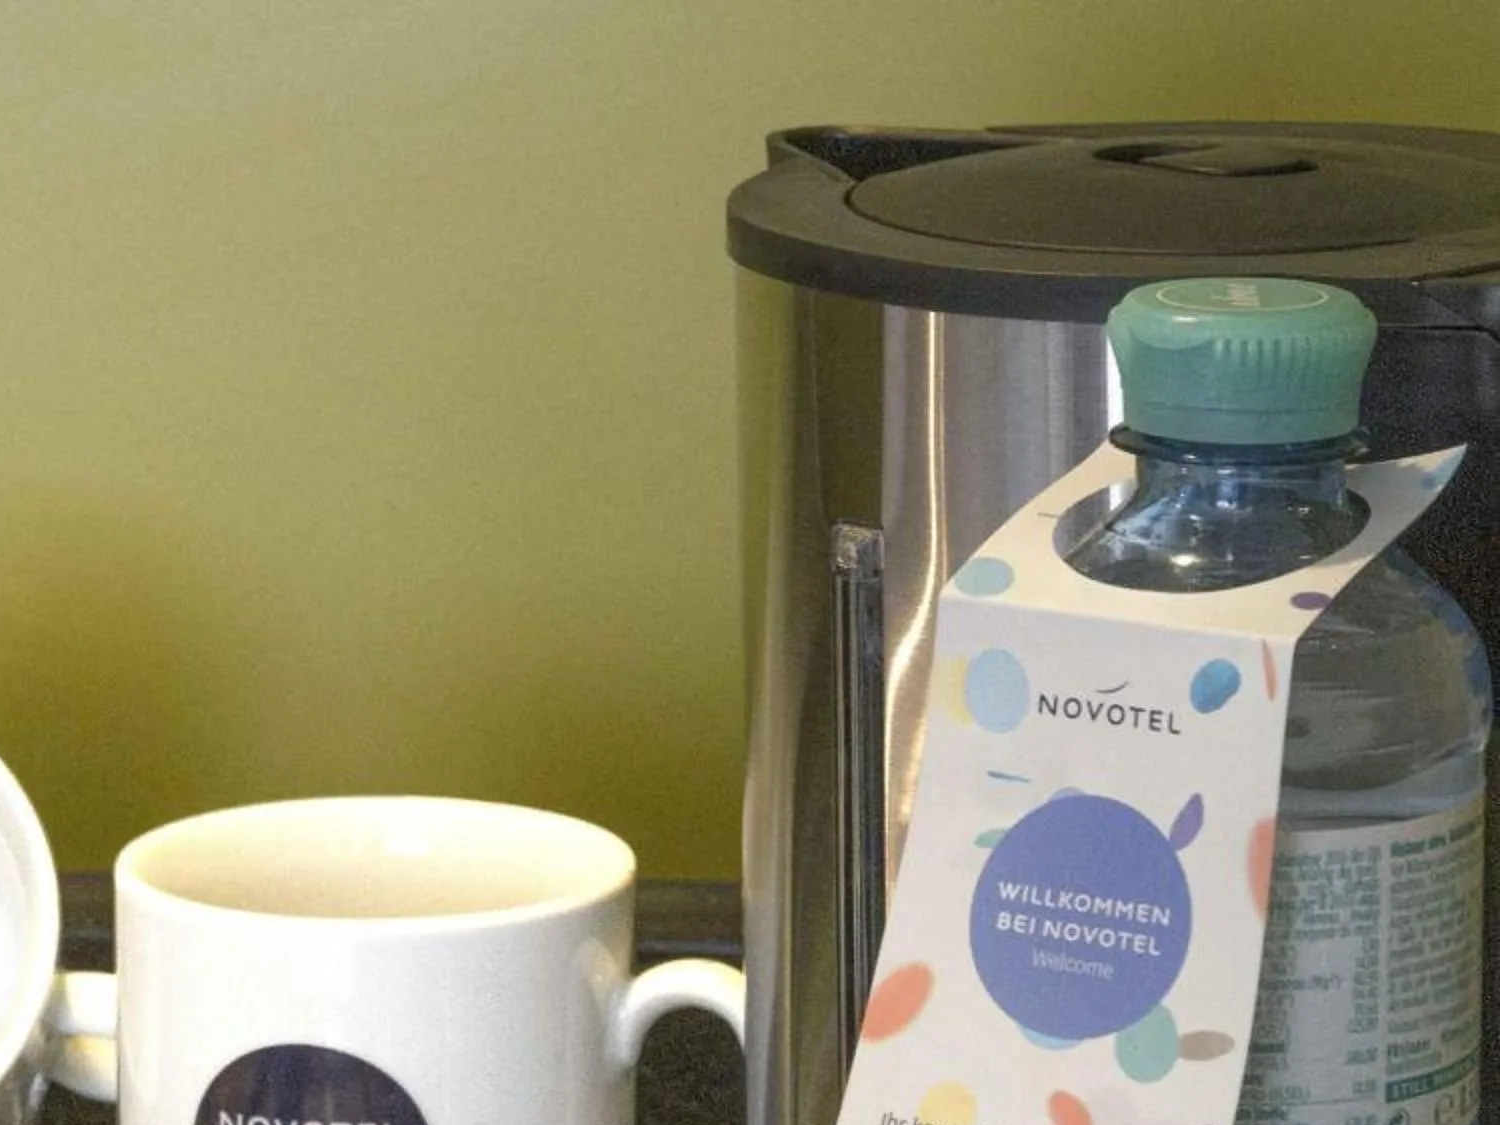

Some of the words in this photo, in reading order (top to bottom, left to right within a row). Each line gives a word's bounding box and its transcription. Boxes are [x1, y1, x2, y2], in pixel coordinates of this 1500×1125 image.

[1037, 691, 1182, 735] NOVOTEL
[997, 880, 1172, 926] WILLKOMMEN
[995, 911, 1036, 935] BEI
[1041, 919, 1161, 957] NOVOTEL
[1031, 949, 1115, 980] Welcome
